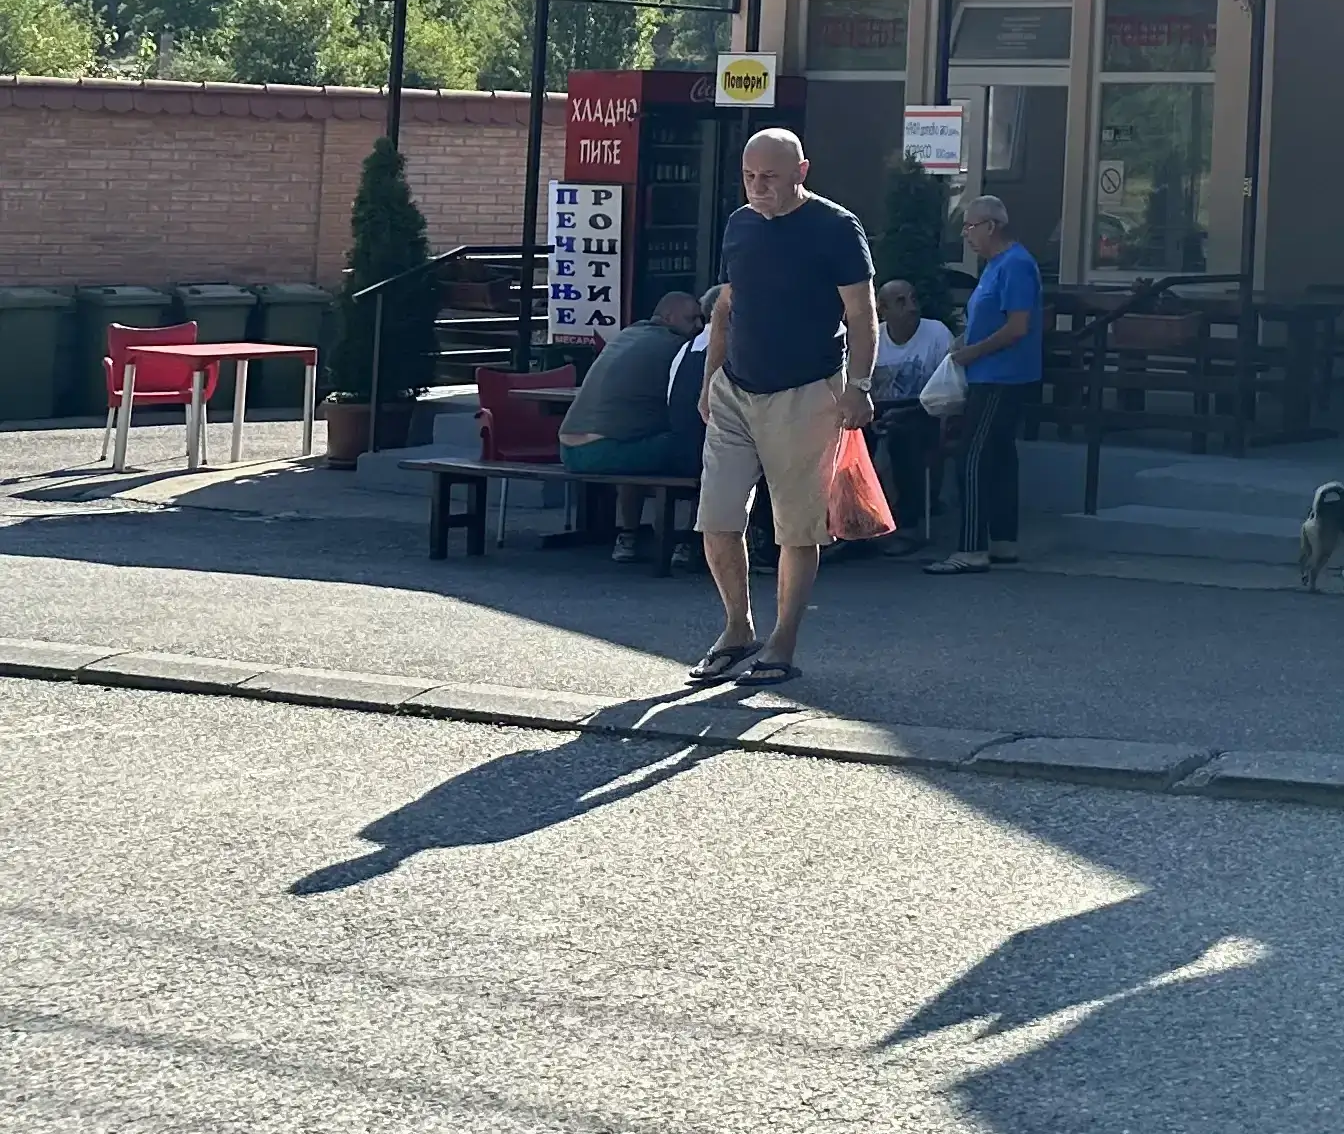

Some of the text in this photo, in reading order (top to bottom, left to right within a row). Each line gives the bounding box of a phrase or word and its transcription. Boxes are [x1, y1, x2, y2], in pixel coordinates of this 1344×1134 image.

[571, 97, 638, 127] ХЛАДНО
[580, 138, 622, 165] ПИЋЕ
[551, 188, 582, 325] ПЕЧЕЊЕ
[582, 188, 618, 327] РОШТИЉ
